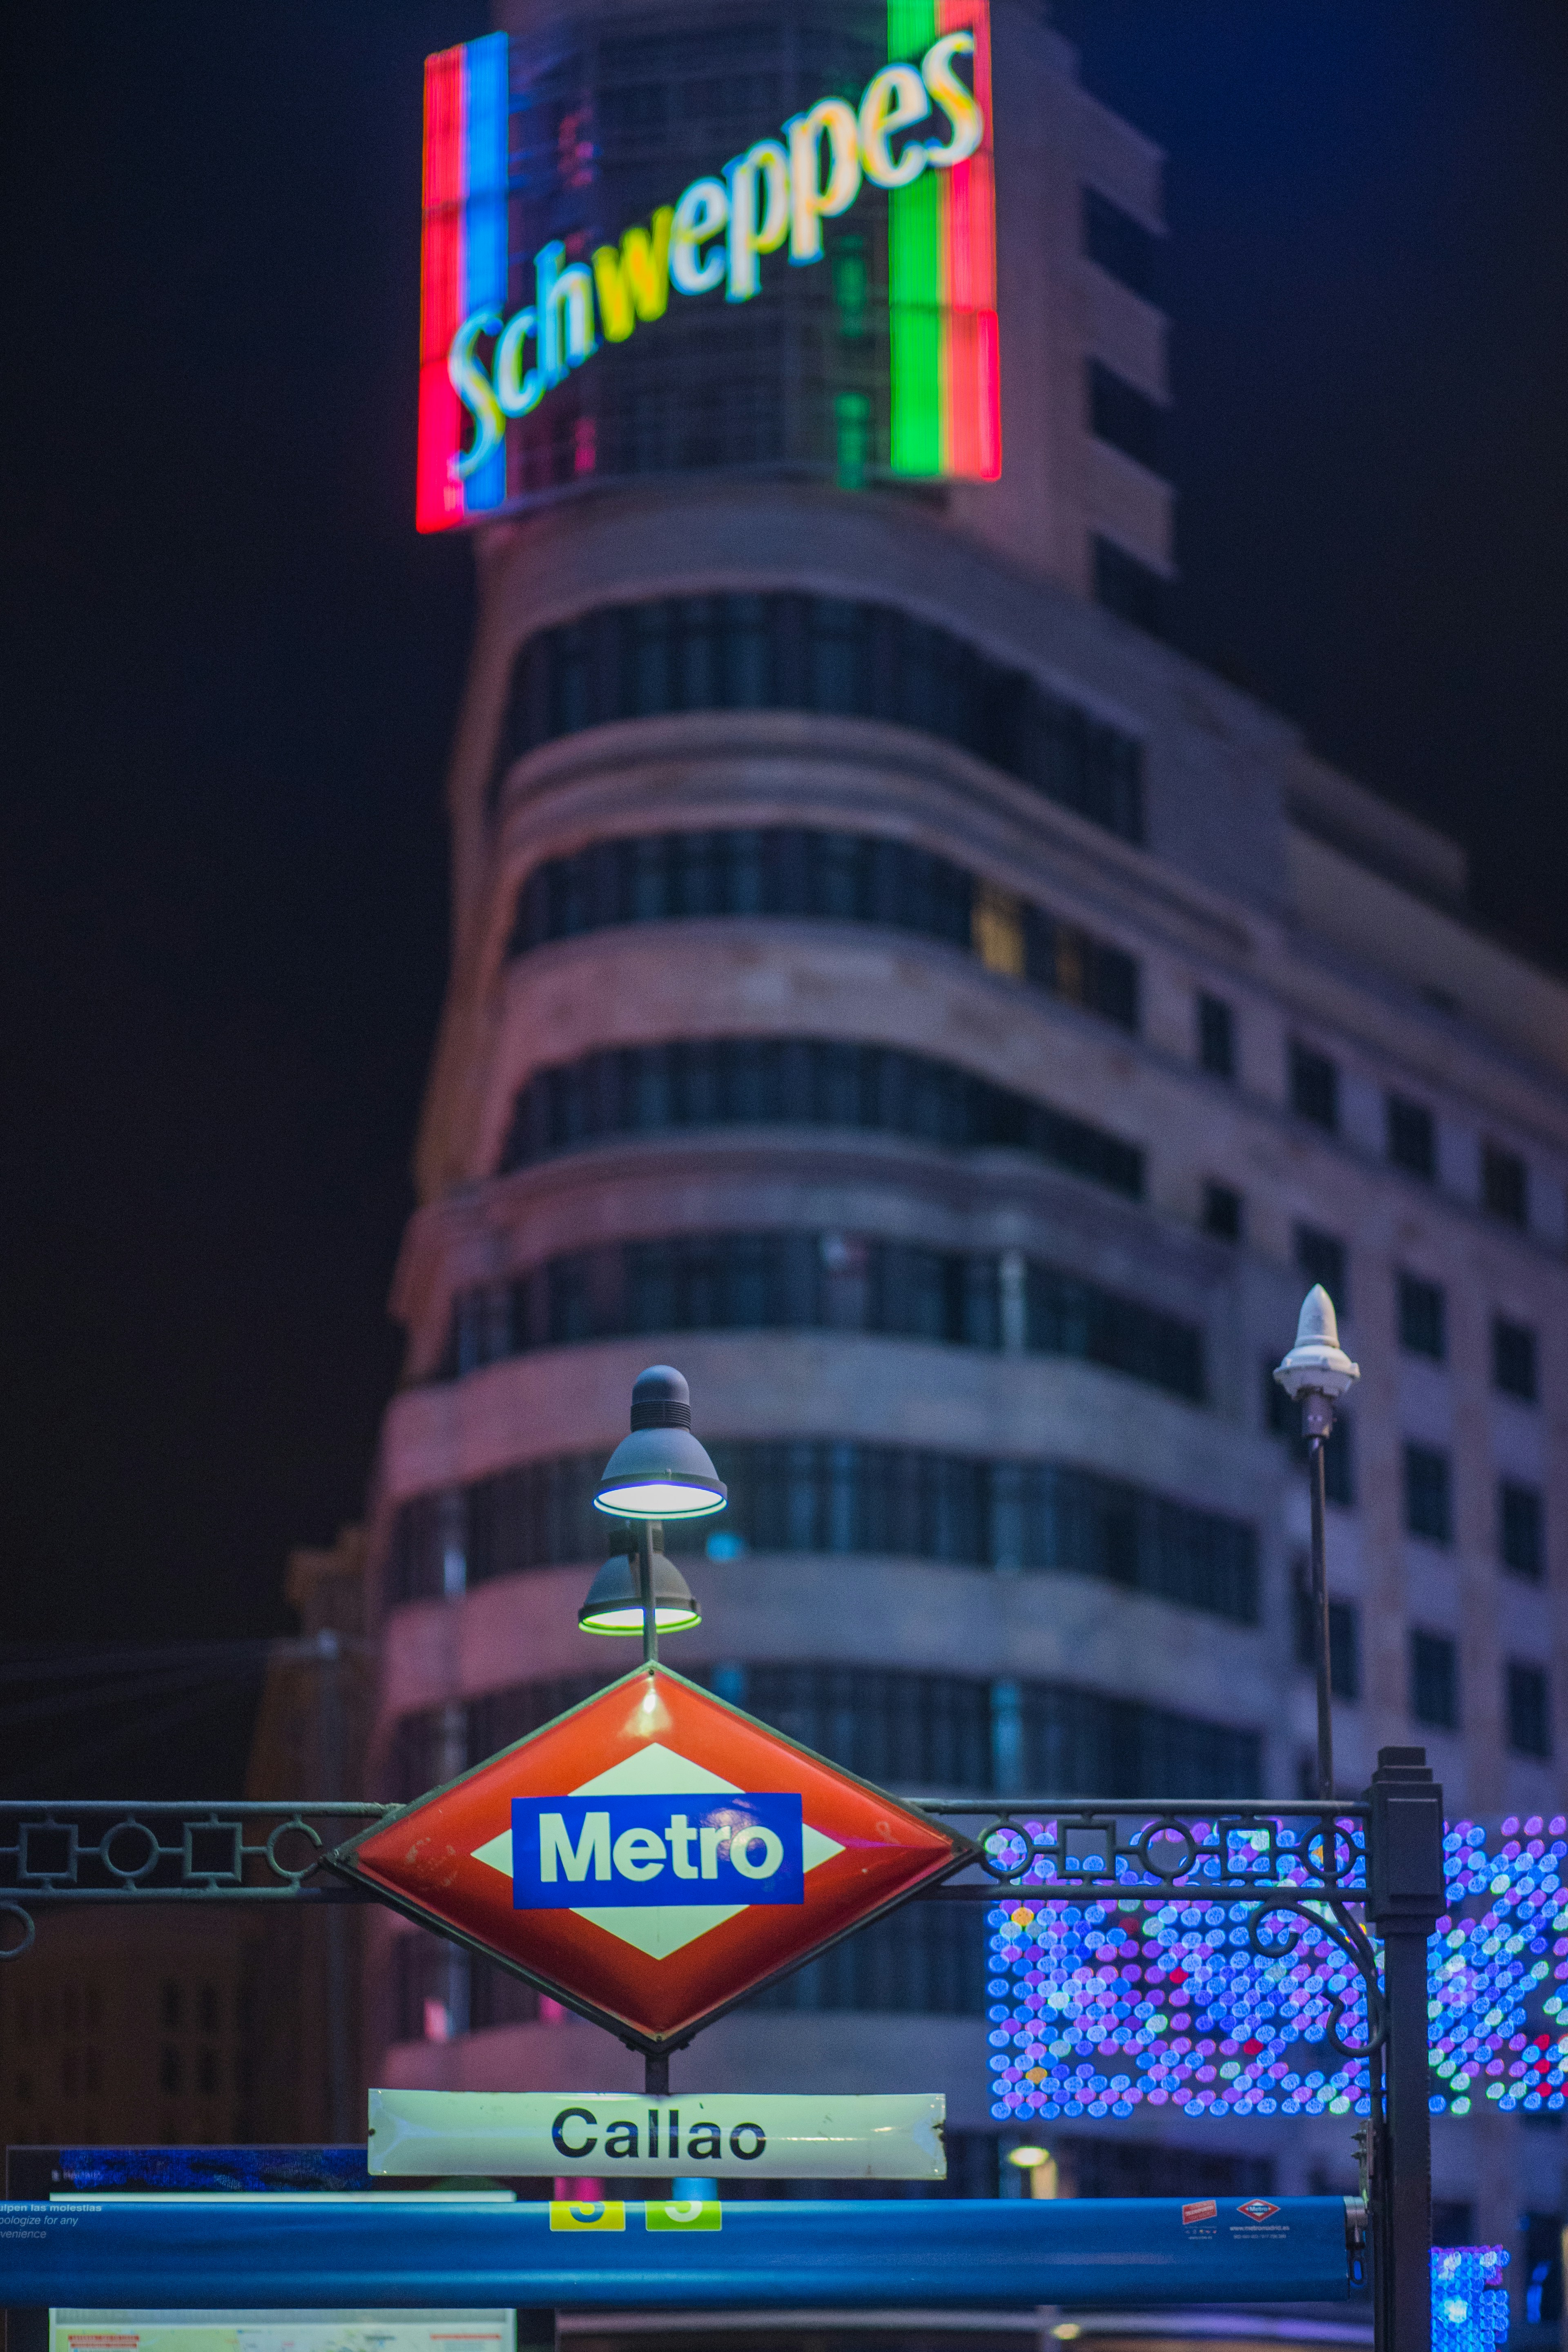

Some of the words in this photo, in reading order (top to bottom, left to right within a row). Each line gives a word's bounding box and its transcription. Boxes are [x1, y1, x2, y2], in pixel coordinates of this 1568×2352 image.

[449, 32, 983, 480] Schweppes
[539, 1812, 784, 1882] Metro
[552, 2107, 766, 2160] Callao
[44, 2216, 57, 2225] for
[60, 2218, 78, 2226] any
